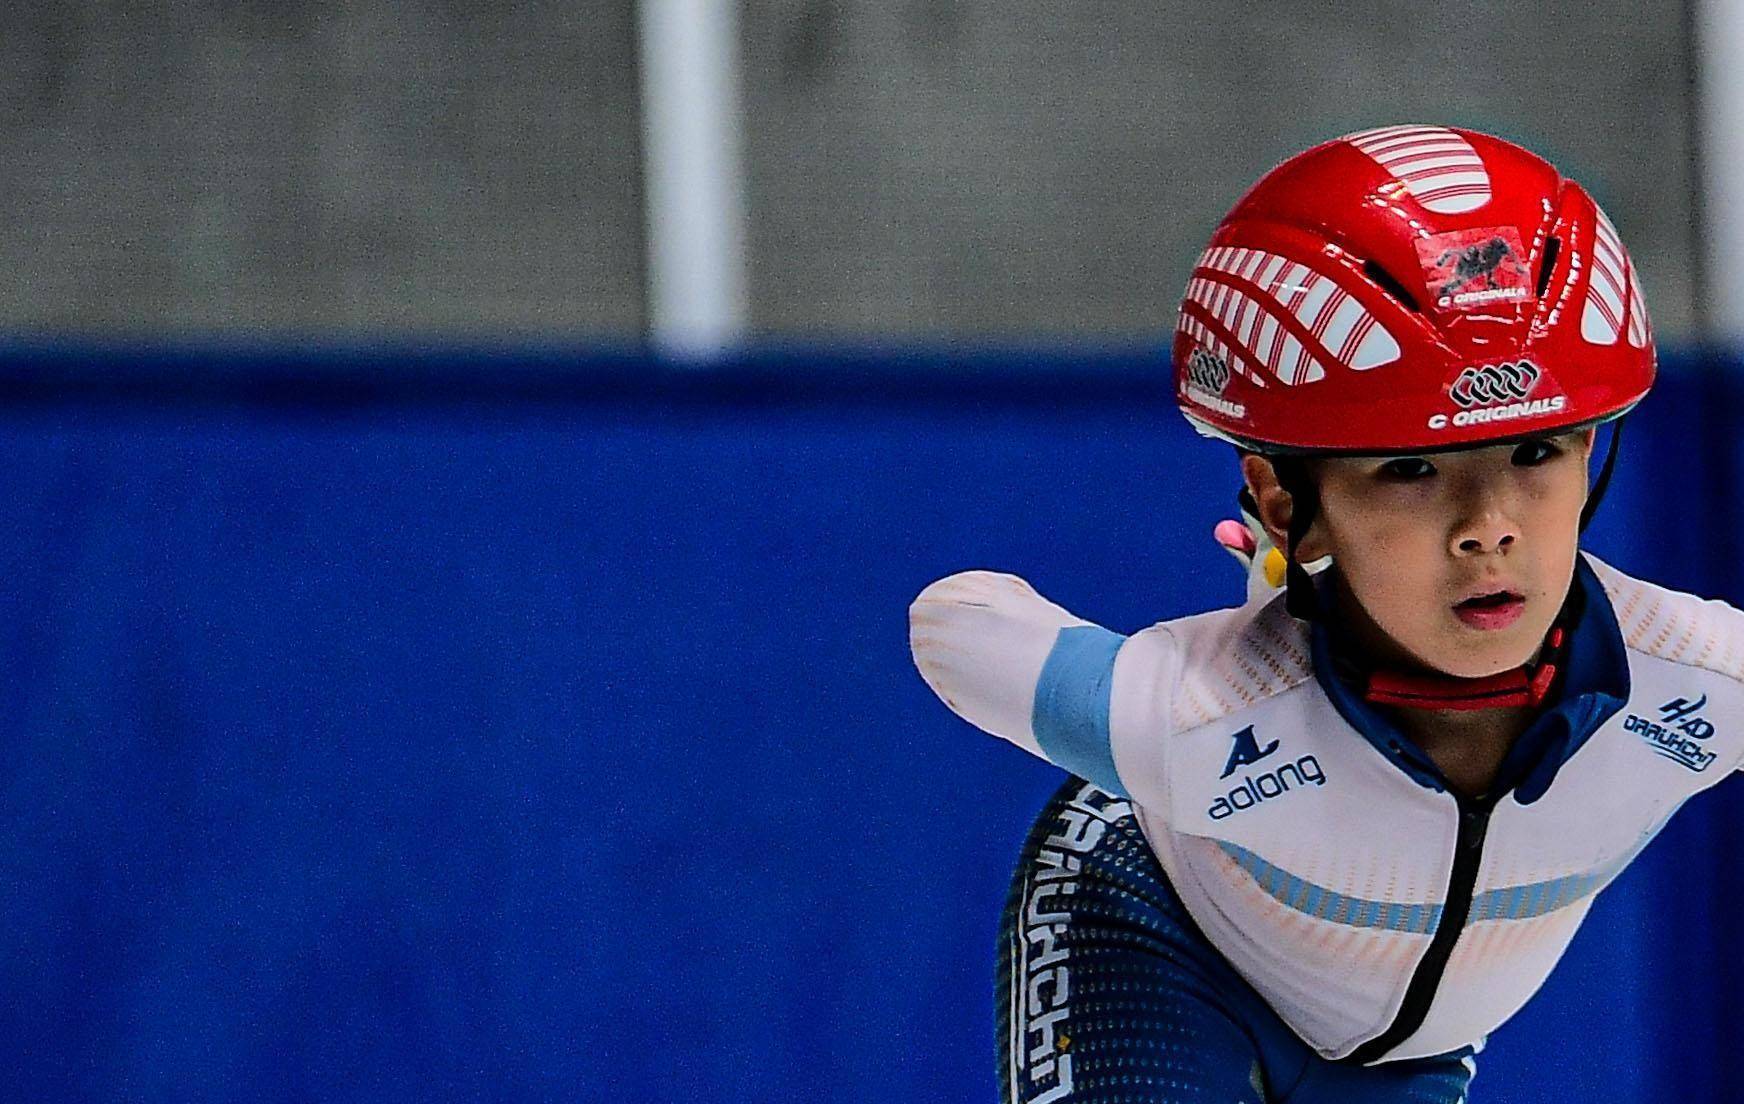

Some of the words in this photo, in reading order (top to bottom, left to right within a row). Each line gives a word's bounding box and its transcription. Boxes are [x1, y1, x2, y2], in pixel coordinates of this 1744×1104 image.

[1428, 414, 1447, 429] C
[1452, 396, 1566, 427] ORIGINALS
[1208, 755, 1326, 820] aolong
